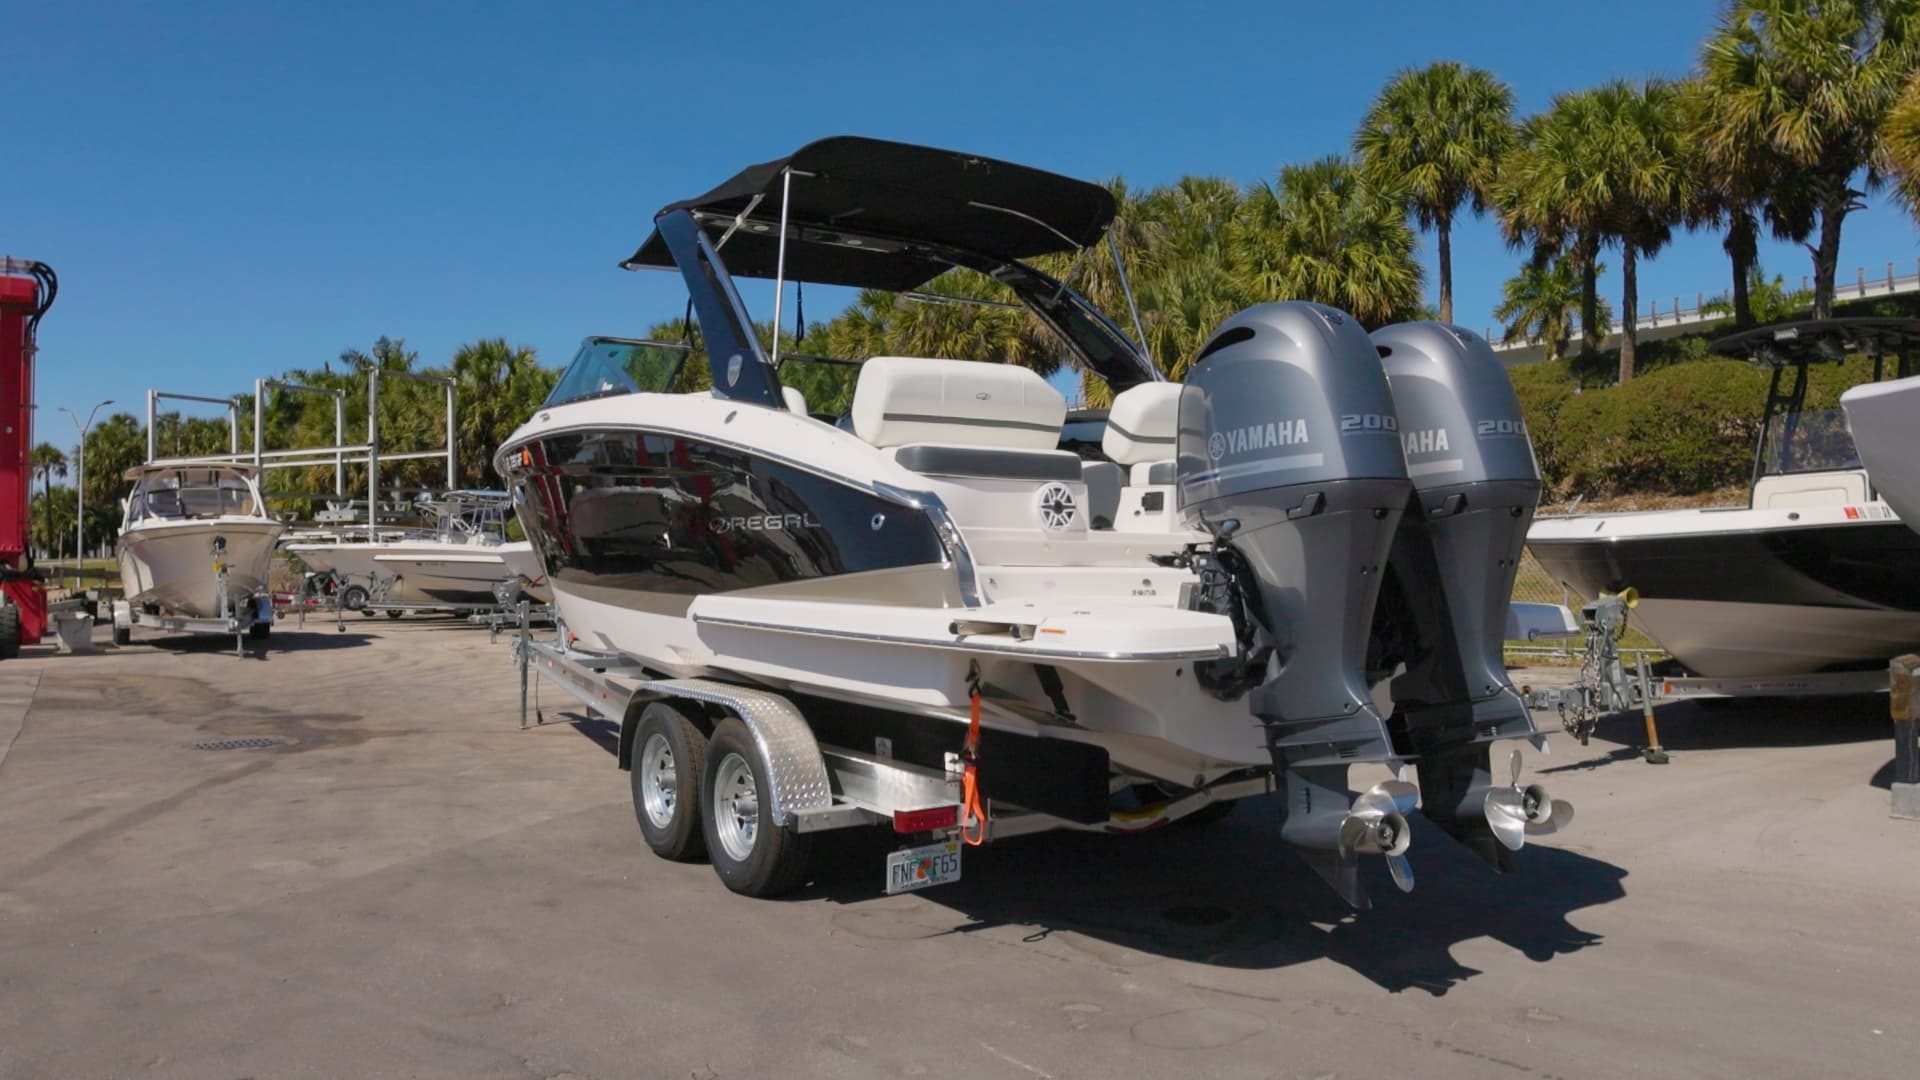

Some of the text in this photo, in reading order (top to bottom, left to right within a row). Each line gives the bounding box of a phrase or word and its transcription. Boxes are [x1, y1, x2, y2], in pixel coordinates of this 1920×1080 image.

[1341, 414, 1397, 431] 200
[1226, 418, 1309, 455] YAMAHA
[1406, 428, 1449, 455] AHA
[730, 512, 822, 531] REGAL
